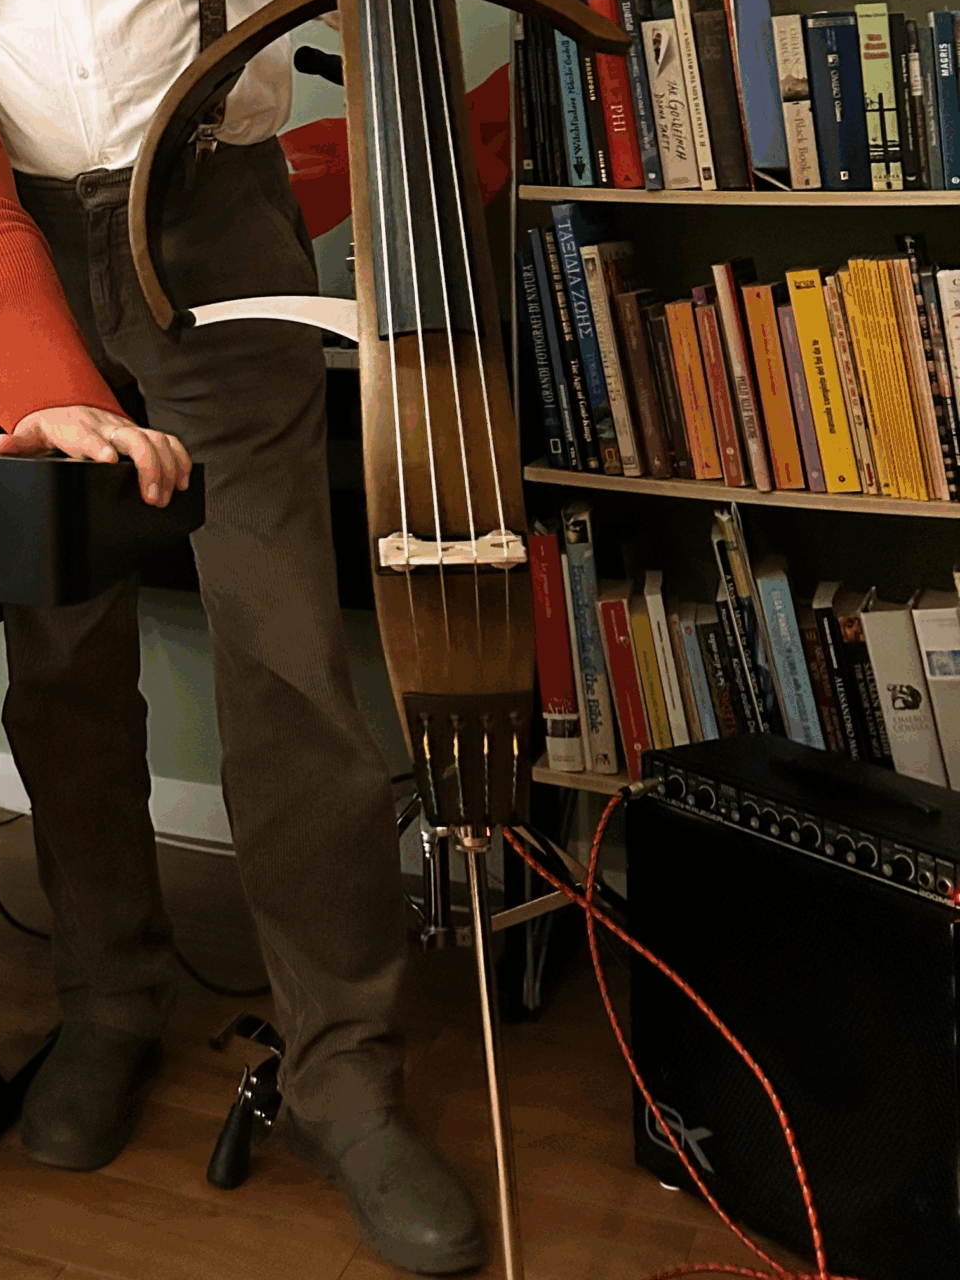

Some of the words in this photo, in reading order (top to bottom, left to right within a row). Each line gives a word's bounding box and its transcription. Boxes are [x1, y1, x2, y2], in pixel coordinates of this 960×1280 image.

[778, 30, 790, 65] PAMUK
[790, 28, 801, 64] ORHAN
[939, 43, 950, 77] MAGRIS
[585, 57, 596, 101] PERSEPOLIS
[830, 70, 841, 99] OMERO
[610, 104, 627, 132] PHI
[654, 92, 665, 121] DONNA
[658, 121, 671, 152] TARTT
[795, 117, 808, 149] Black
[798, 148, 812, 173] Book
[521, 264, 539, 301] NATURA
[558, 219, 581, 286] ΤΑΞΙΔΙΑ
[572, 289, 593, 339] ΖΩΗΣ
[528, 302, 540, 313] DI
[529, 314, 549, 365] FOTOGRAFI
[570, 359, 580, 373] The
[538, 365, 555, 403] GRANDI
[570, 375, 583, 391] Age
[576, 391, 585, 400] of
[736, 376, 748, 395] POLLO
[578, 401, 593, 443] God-Kings
[571, 565, 595, 654] Encyclopedia
[582, 656, 598, 673] of
[854, 663, 863, 677] THE
[585, 672, 599, 695] the
[587, 698, 603, 734] Bible
[834, 675, 855, 738] ALESSANDRO
[847, 738, 860, 762] MAG
[863, 662, 881, 709] SALMAN
[874, 710, 891, 757] RUSHDIE
[865, 716, 877, 737] LAST
[870, 737, 882, 759] SIGH
